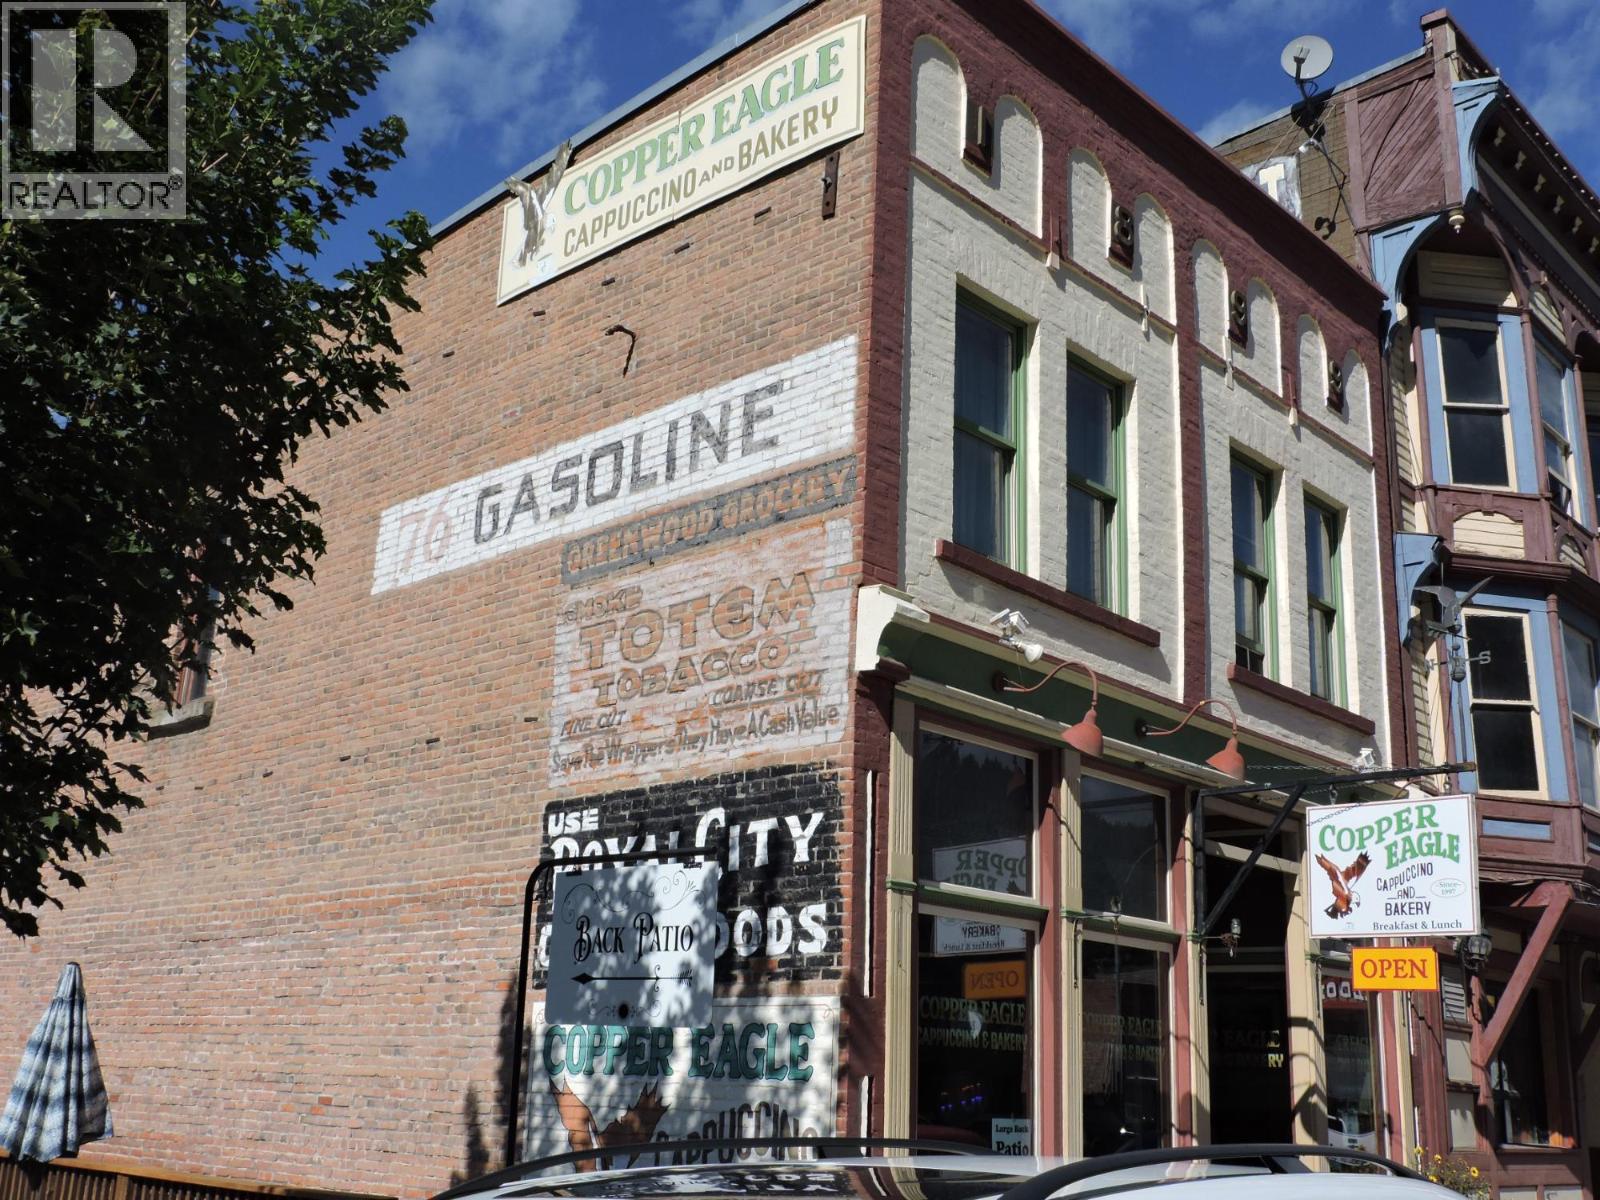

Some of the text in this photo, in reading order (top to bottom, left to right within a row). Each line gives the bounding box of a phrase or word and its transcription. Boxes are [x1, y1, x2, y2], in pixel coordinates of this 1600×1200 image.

[564, 37, 845, 217] COPPER EAGLE
[563, 95, 839, 258] CAPPUCCINO AND BAKERY
[473, 379, 785, 545] GASOLINE
[579, 571, 816, 670] TOTEM
[592, 636, 790, 707] TOBACCO
[759, 706, 795, 737] Cash
[794, 698, 840, 731] Value
[547, 808, 599, 838] USE
[694, 806, 825, 881] CITY
[1318, 804, 1439, 852] COPPER
[1384, 831, 1460, 870] EAGLE
[1376, 862, 1434, 892] CAPPUCCINO
[1397, 886, 1416, 900] AND
[1373, 919, 1463, 931] Breakfast & Lunch
[1385, 901, 1431, 917] BAKERY
[573, 914, 625, 966] BACK
[633, 911, 694, 965] PATIO
[714, 903, 828, 960] OODS
[1360, 958, 1429, 979] OPEN
[919, 995, 1026, 1026] COPPER EAGLE
[543, 1022, 816, 1082] COPPER EAGLE
[995, 1141, 1029, 1156] Patio
